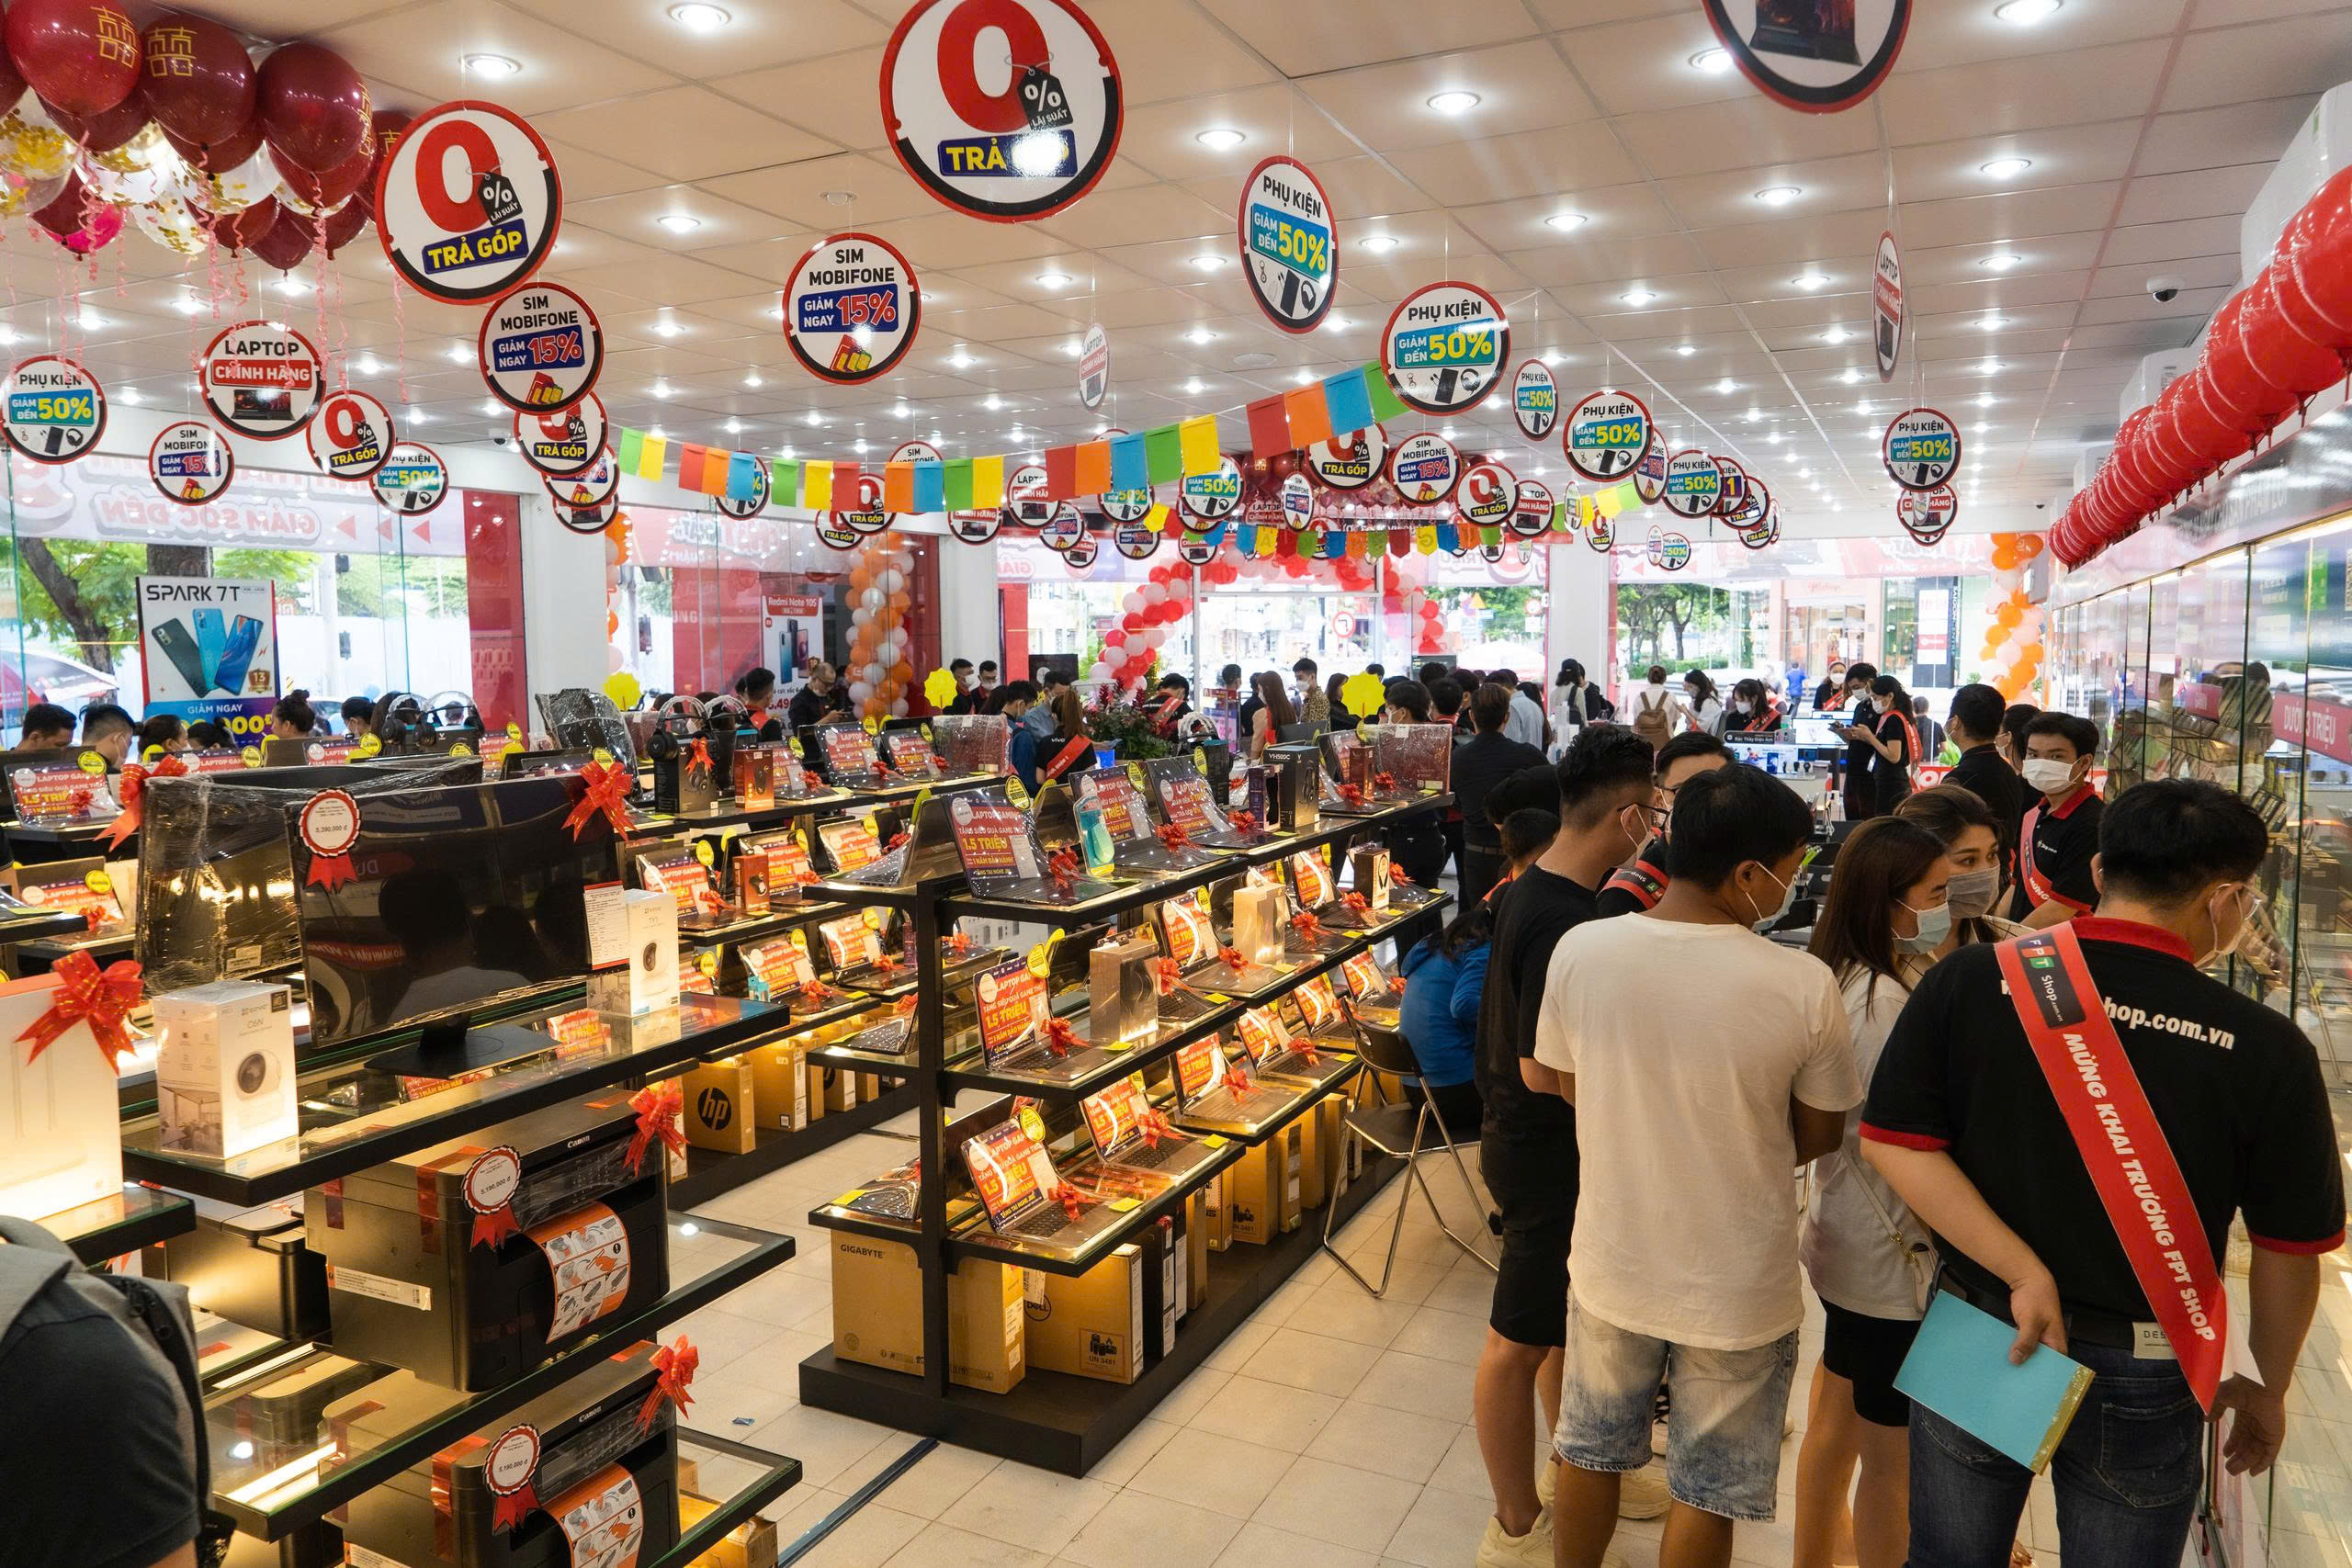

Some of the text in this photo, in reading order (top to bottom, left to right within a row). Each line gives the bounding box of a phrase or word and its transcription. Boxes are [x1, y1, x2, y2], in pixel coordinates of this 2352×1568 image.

[937, 0, 1050, 133] 0
[946, 138, 1007, 172] TRẢ
[416, 119, 502, 233] 0
[1263, 175, 1321, 218] PHỤ KIỆN
[1254, 211, 1277, 232] GIẢM
[427, 229, 523, 269] TRẢ GÓP
[1258, 232, 1277, 252] ĐẾN
[1278, 222, 1326, 272] 50%
[835, 248, 864, 264] SIM
[809, 267, 895, 286] MOBIFONE
[523, 296, 549, 310] SIM
[804, 296, 833, 311] GIẢM
[836, 294, 896, 325] 15%
[1408, 299, 1482, 322] PHỤ KIỆN
[501, 310, 579, 331] MOBIFONE
[804, 314, 833, 328] NGAY
[224, 340, 300, 356] LAPTOP
[498, 340, 526, 354] GIẢM
[528, 332, 582, 365] 15%
[1398, 334, 1427, 349] GIẢM
[1429, 330, 1492, 361] 50%
[499, 355, 526, 367] NGAY
[1404, 349, 1428, 363] ĐẾN
[19, 371, 83, 388] PHỤ KIỆN
[266, 363, 310, 381] HÃNG
[1521, 371, 1548, 384] PHỤ KIỆN
[12, 396, 36, 409] GIẢM
[1530, 389, 1553, 407] 50%
[17, 406, 37, 420] ĐẾN
[38, 396, 93, 420] 50%
[1583, 402, 1634, 418] PHỤ KIỆN
[180, 430, 198, 438] SIM
[1596, 425, 1640, 445] 50%
[1898, 420, 1944, 434] PHỤ KIỆN
[1416, 439, 1430, 448] SIM
[1578, 435, 1595, 446] ĐẾN
[332, 446, 378, 466] TRẢ GÓP
[537, 442, 585, 457] TRẢ GÓP
[1402, 448, 1447, 459] MOBIFONE
[1911, 440, 1950, 458] 50%
[162, 457, 180, 465] GIẢM
[1401, 464, 1416, 472] GIẢM
[1673, 459, 1711, 471] PHỤ KIỆN
[162, 466, 181, 474] NGAY
[398, 469, 437, 486] 50%
[1325, 463, 1367, 476] TRẢ GÓP
[1417, 460, 1449, 479] 15%
[1204, 478, 1236, 494] 50%
[1685, 476, 1716, 491] 50%
[1118, 490, 1147, 500] 50%
[1472, 502, 1507, 515] TRẢ GÓP
[1532, 501, 1549, 511] HÃNG
[851, 514, 883, 523] TRẢ GÓP
[146, 585, 213, 602] SPARK
[217, 586, 241, 602] 7T
[768, 597, 786, 606] Redmi
[789, 598, 805, 606] Note
[187, 704, 243, 714] GIẢM NGAY
[1103, 803, 1126, 820] TRIỆU
[963, 835, 1008, 852] 1.5 TRIỆU
[2029, 939, 2050, 967] FPT
[998, 976, 1020, 991] LAPTOP
[986, 1000, 1027, 1029] 1.5 TRIỆU
[701, 1087, 729, 1131] hp
[567, 1134, 591, 1149] Canon
[984, 1180, 999, 1196] 1.5
[2063, 1032, 2217, 1342] MỪNG KHAI TRƯƠNG FPT SHOP
[840, 1244, 884, 1259] GIGABYTE
[1088, 1355, 1101, 1364] UN
[579, 1406, 602, 1423] Canon
